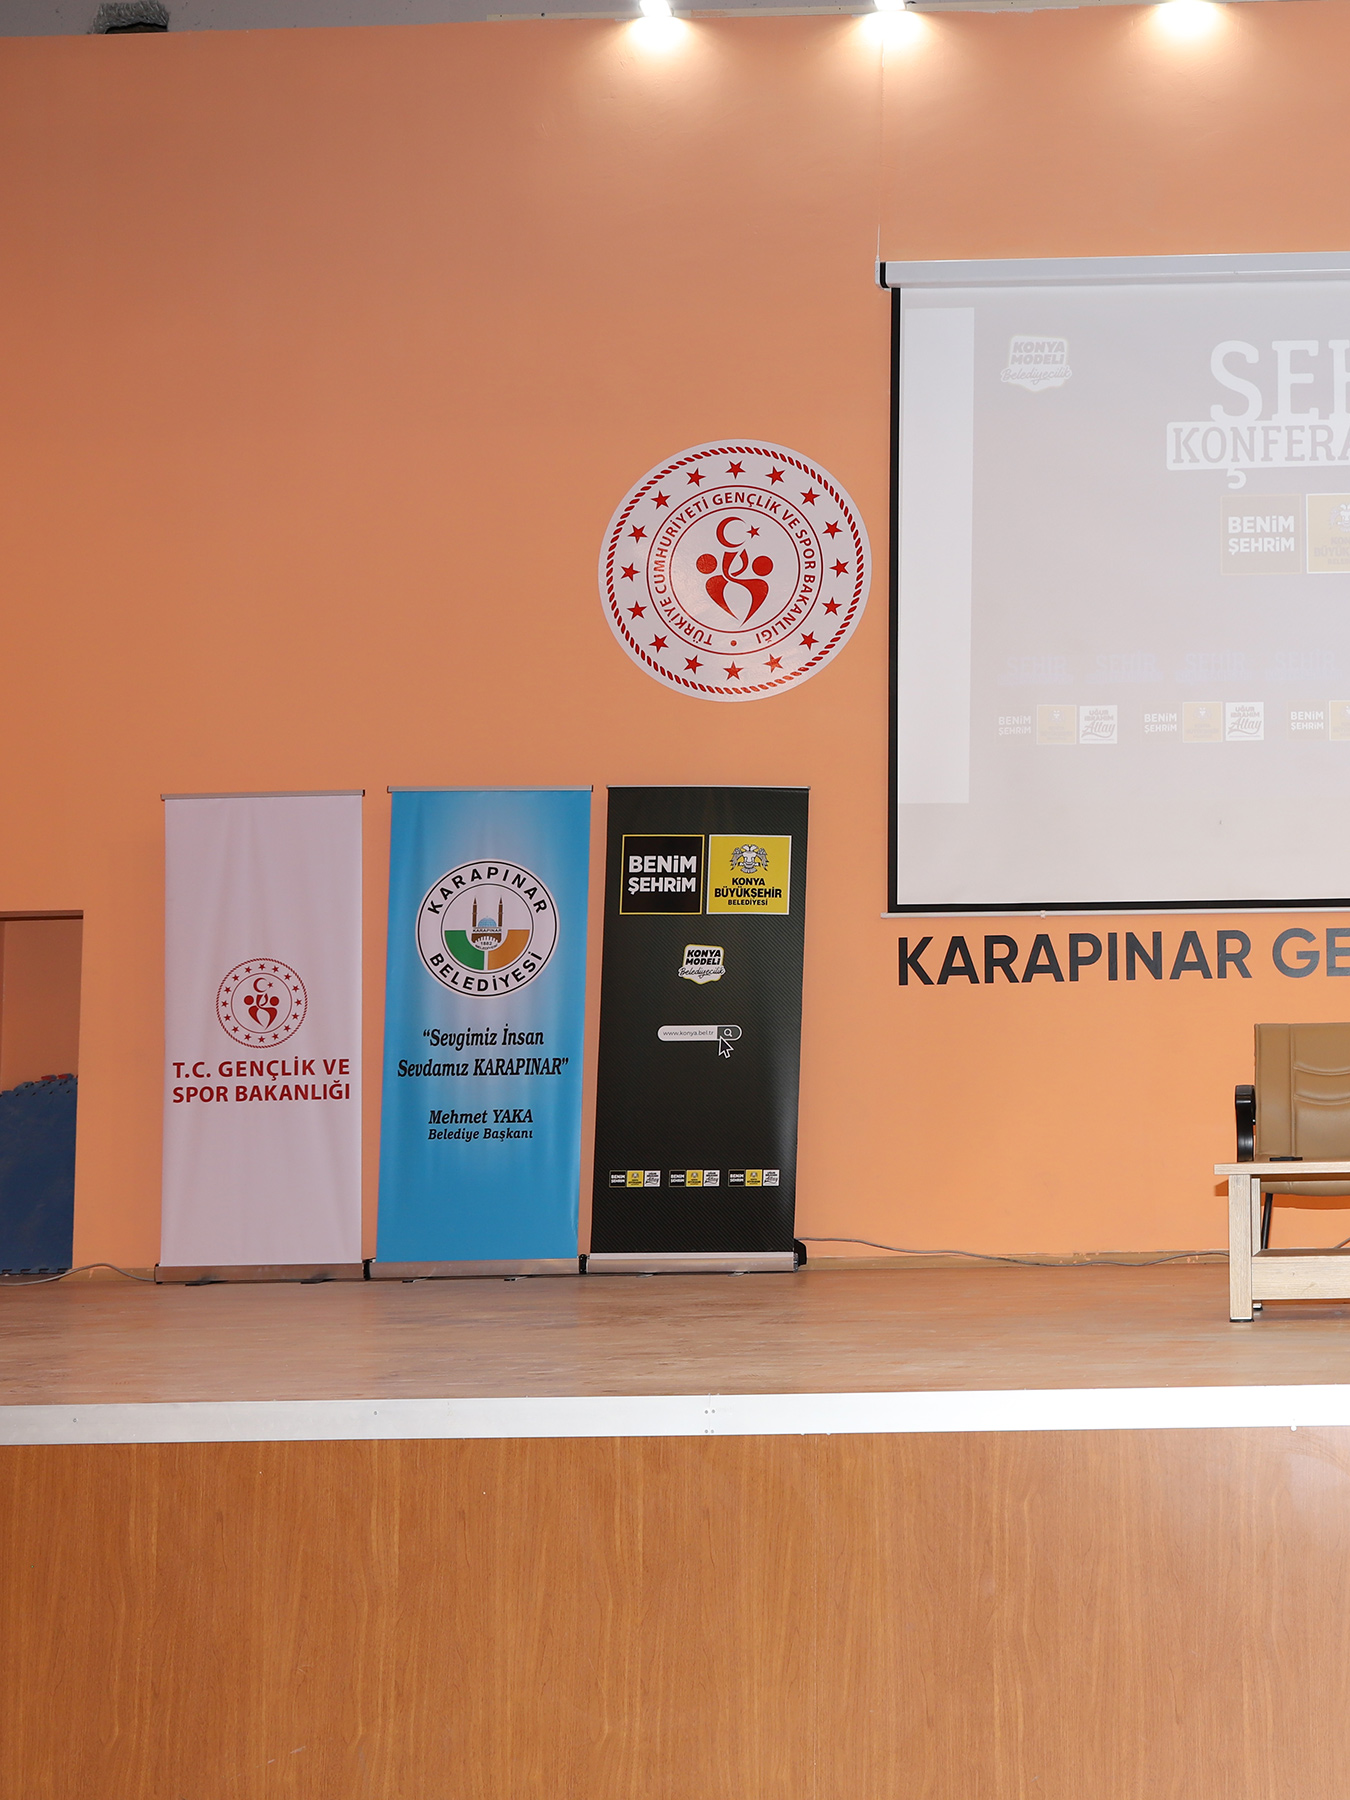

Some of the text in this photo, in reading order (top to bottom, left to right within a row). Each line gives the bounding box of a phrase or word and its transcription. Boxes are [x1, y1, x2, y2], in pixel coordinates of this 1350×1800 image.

[1013, 341, 1065, 353] KONYA
[1002, 367, 1071, 385] Belediyecilik
[653, 491, 816, 646] TÜRKİYE CUMHURİYETİ GENÇLİK VE SPOR BAKANLIĞI
[427, 866, 548, 915] KARAPINAR
[732, 877, 766, 886] KONYA
[714, 886, 782, 899] BÜYÜKŞEHİR
[896, 929, 1253, 987] KARAPINAR
[429, 951, 542, 992] BELEDİYESİ
[501, 1023, 545, 1046] İnsan
[172, 1056, 350, 1081] T.C. GENÇLİK VE
[397, 1059, 469, 1078] Sevdamız
[172, 1080, 350, 1103] SPOR BAKANLIĞI
[428, 1109, 533, 1125] Mehmet YAKA
[427, 1128, 533, 1142] Belediye Başkanı
